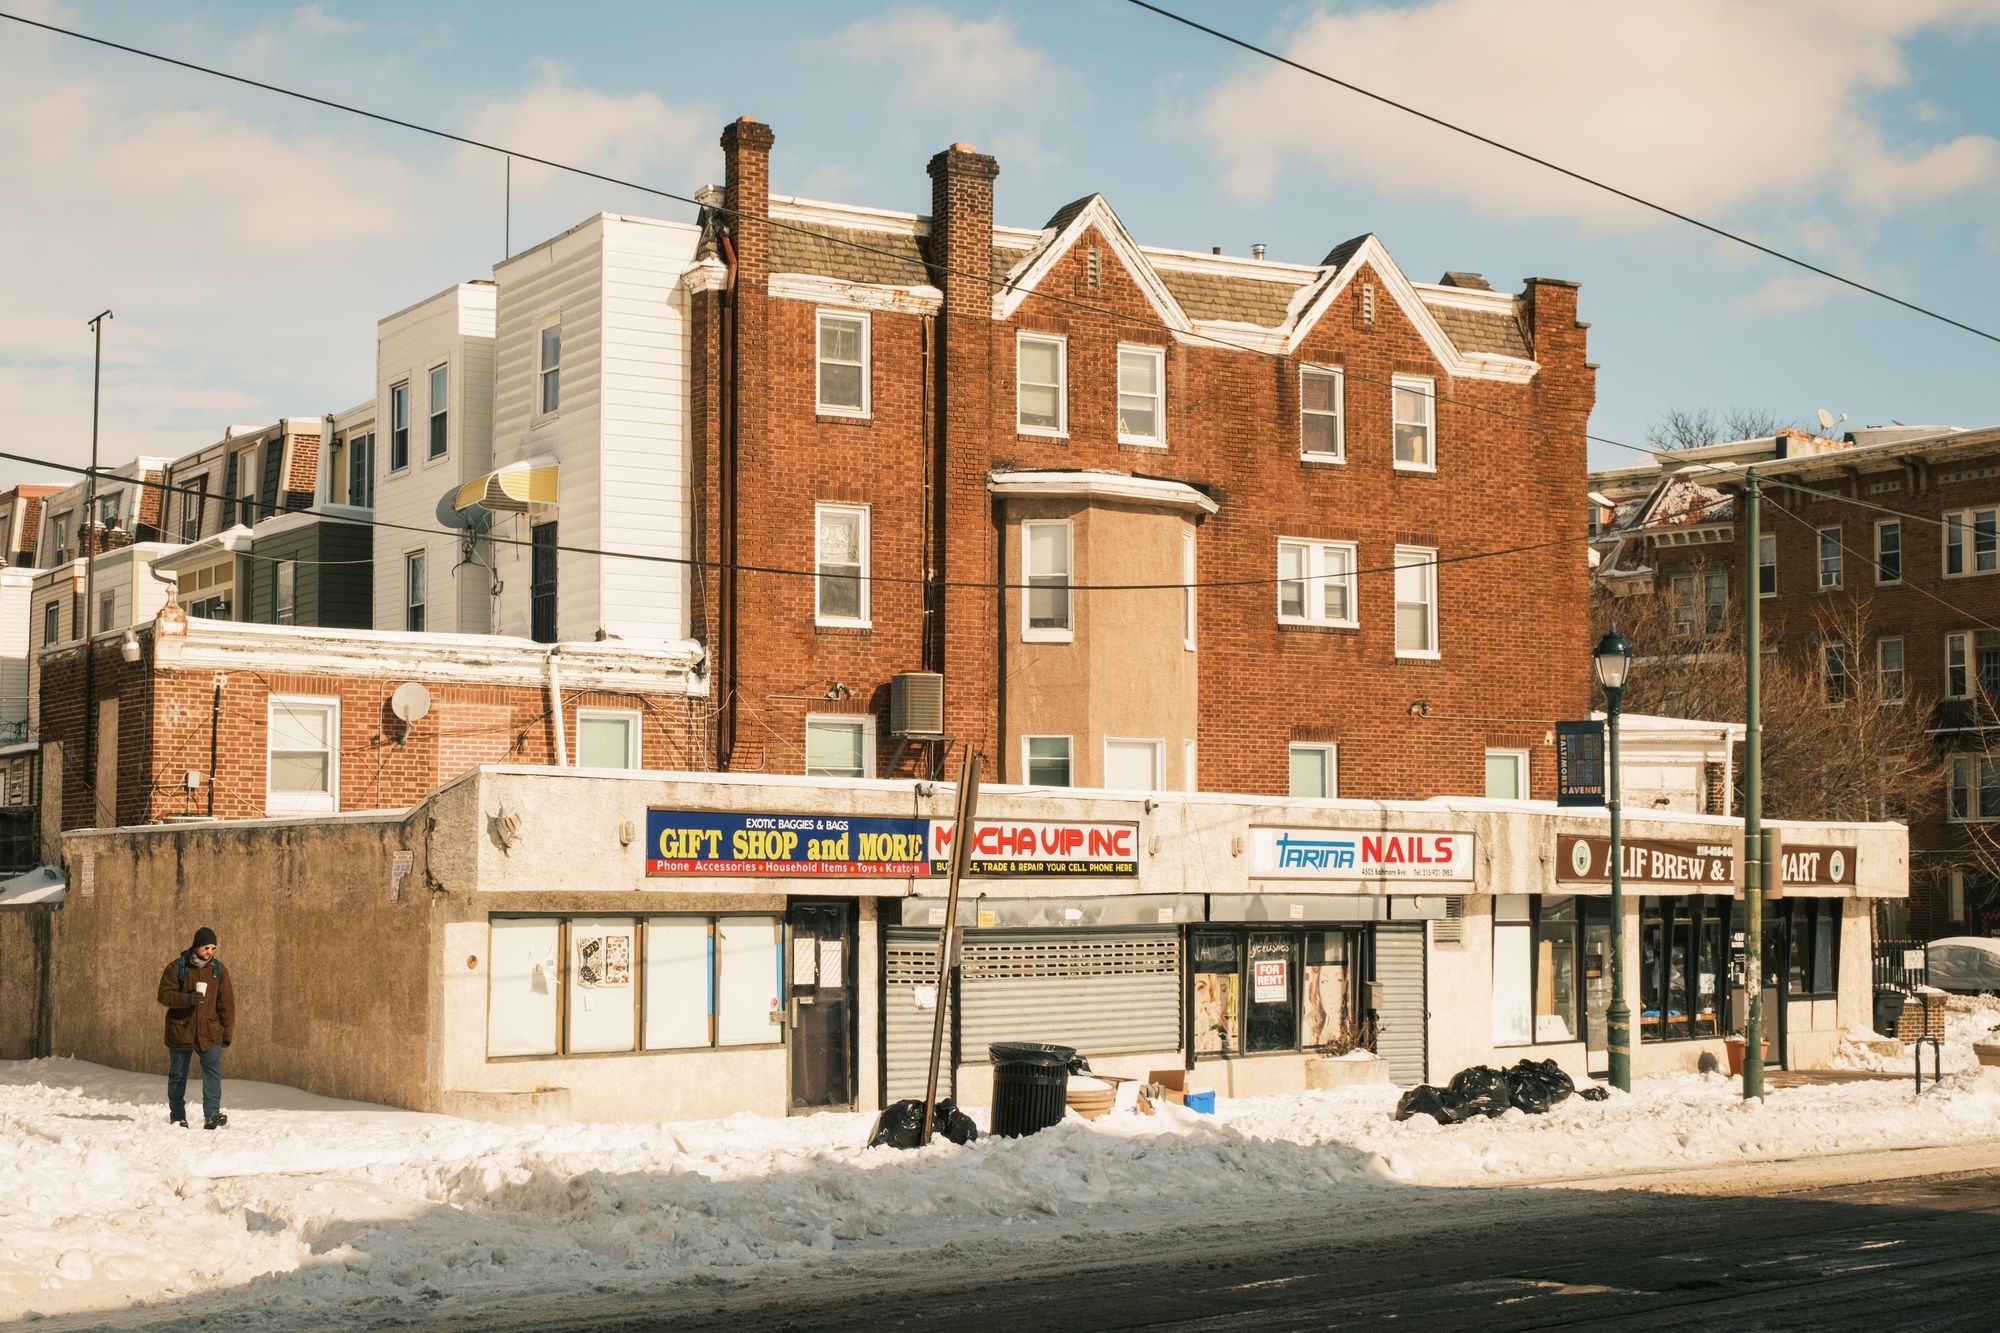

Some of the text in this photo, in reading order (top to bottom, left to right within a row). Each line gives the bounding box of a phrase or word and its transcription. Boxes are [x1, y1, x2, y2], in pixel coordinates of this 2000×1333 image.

[746, 819, 848, 830] EXOTIC BAGGIES & BAGS
[660, 828, 922, 861] GIFT SHOP and MORE
[935, 826, 1131, 857] MCHA VIP INC
[1362, 836, 1453, 863] NAILS
[657, 861, 689, 870] Phone
[695, 861, 756, 871] Accessories
[766, 862, 817, 871] Household
[821, 863, 847, 872] Items
[857, 863, 877, 872] Toys
[982, 863, 1008, 872] TRADE
[1010, 863, 1016, 872] &
[1019, 863, 1044, 872] REPAIR
[1047, 863, 1066, 872] YOUR
[1069, 864, 1087, 872] CELL
[1089, 864, 1114, 872] PHONE
[1116, 864, 1133, 873] HERE
[1651, 851, 1705, 880] BREW
[1710, 860, 1725, 880] &
[1260, 965, 1279, 974] FOR
[1257, 975, 1283, 985] RENT
